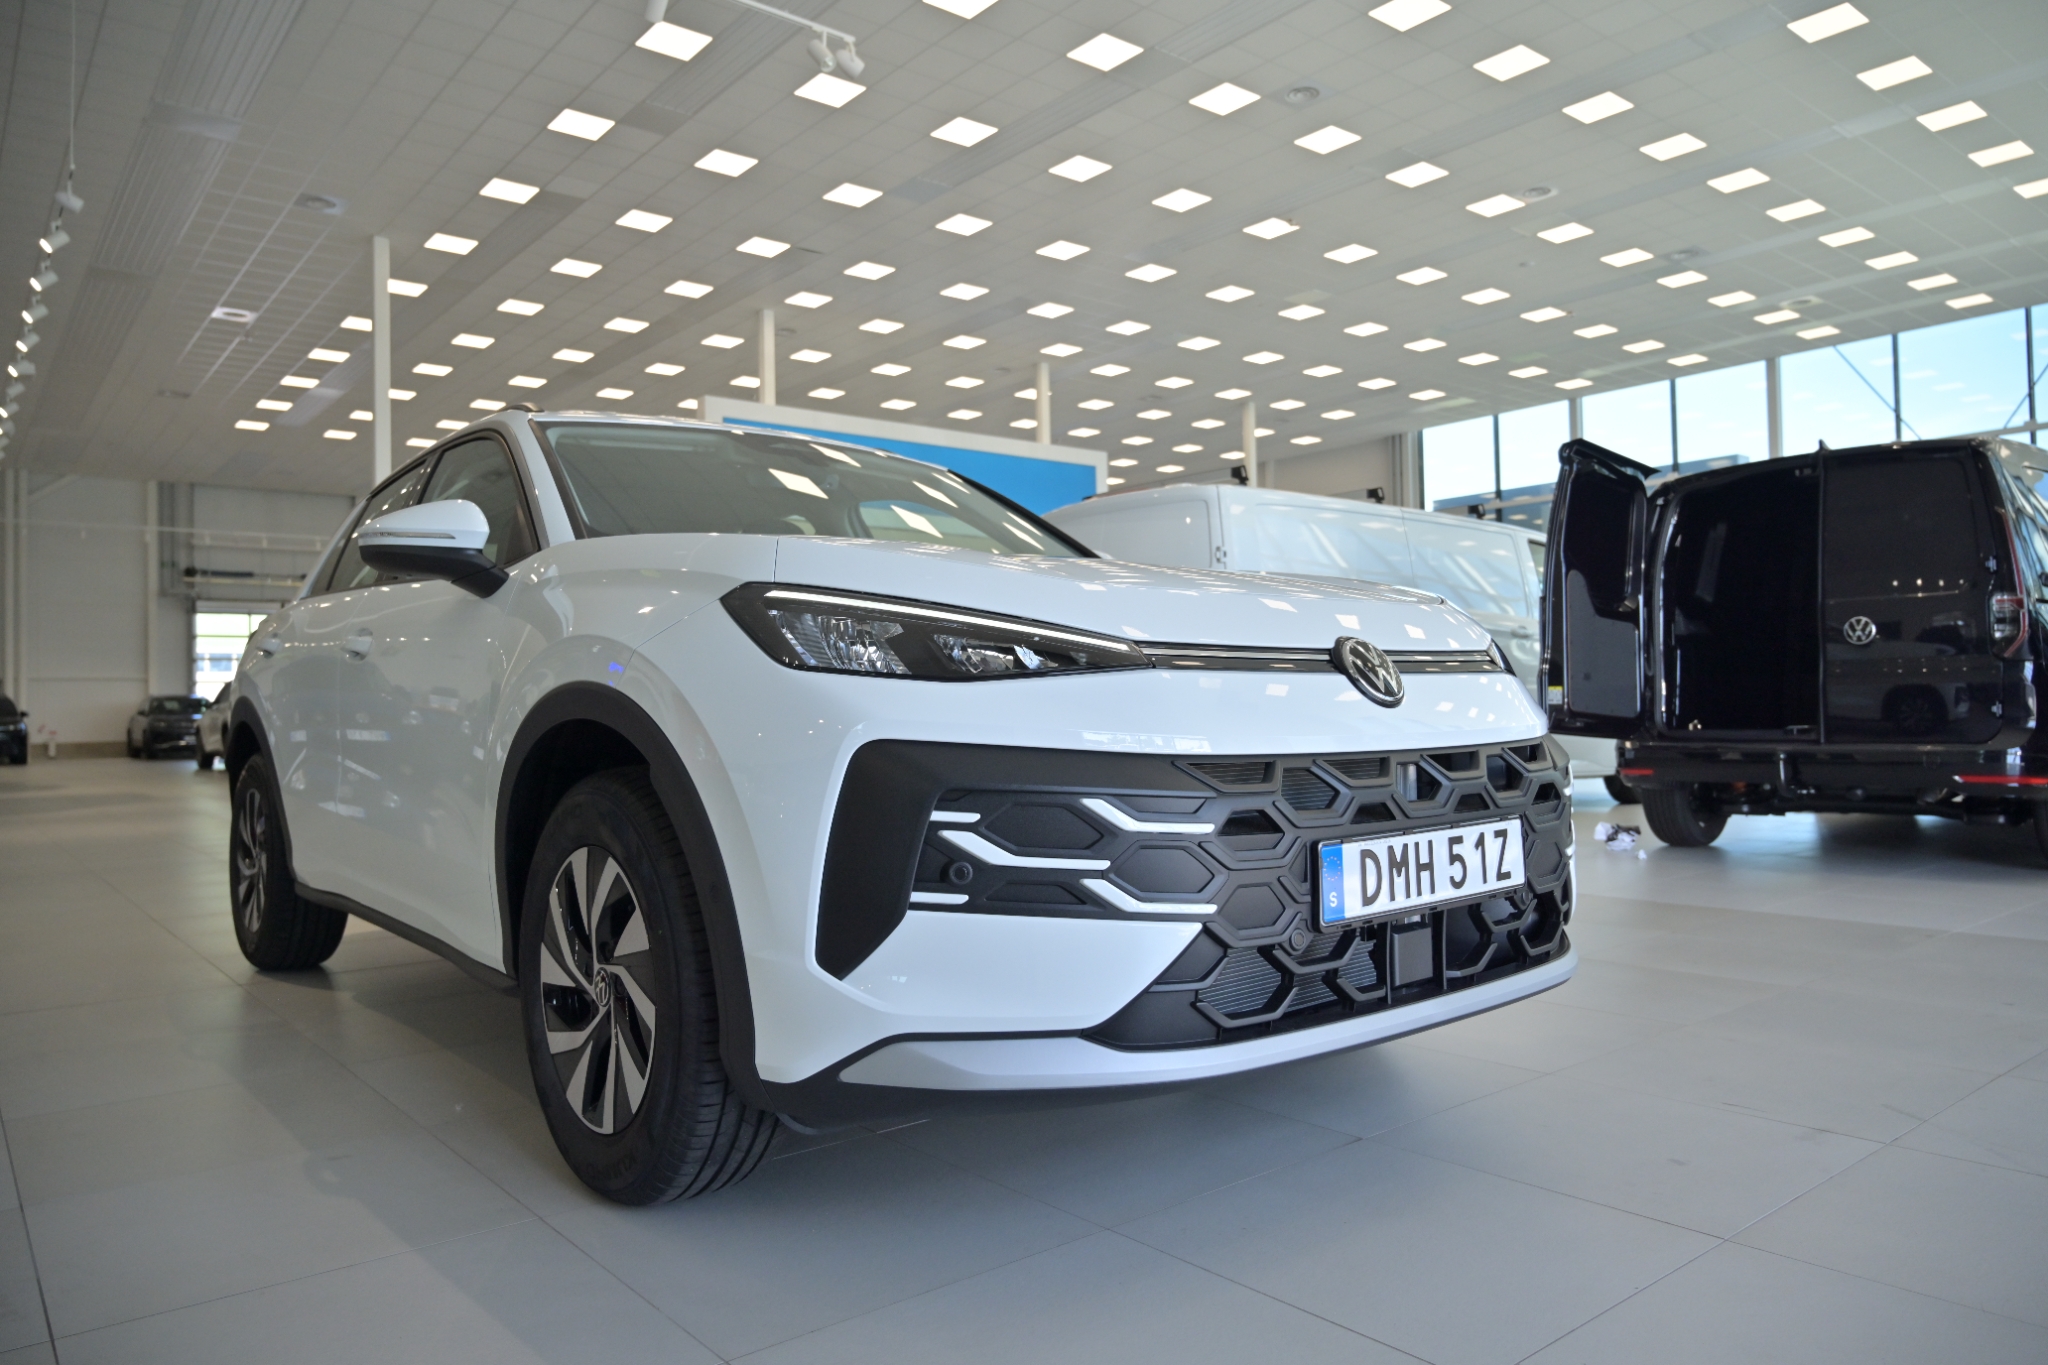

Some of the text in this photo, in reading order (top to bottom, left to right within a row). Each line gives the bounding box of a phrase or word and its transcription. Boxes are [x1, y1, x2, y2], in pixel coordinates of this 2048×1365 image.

[1360, 828, 1512, 907] DMH 51Z
[1329, 891, 1338, 908] S
